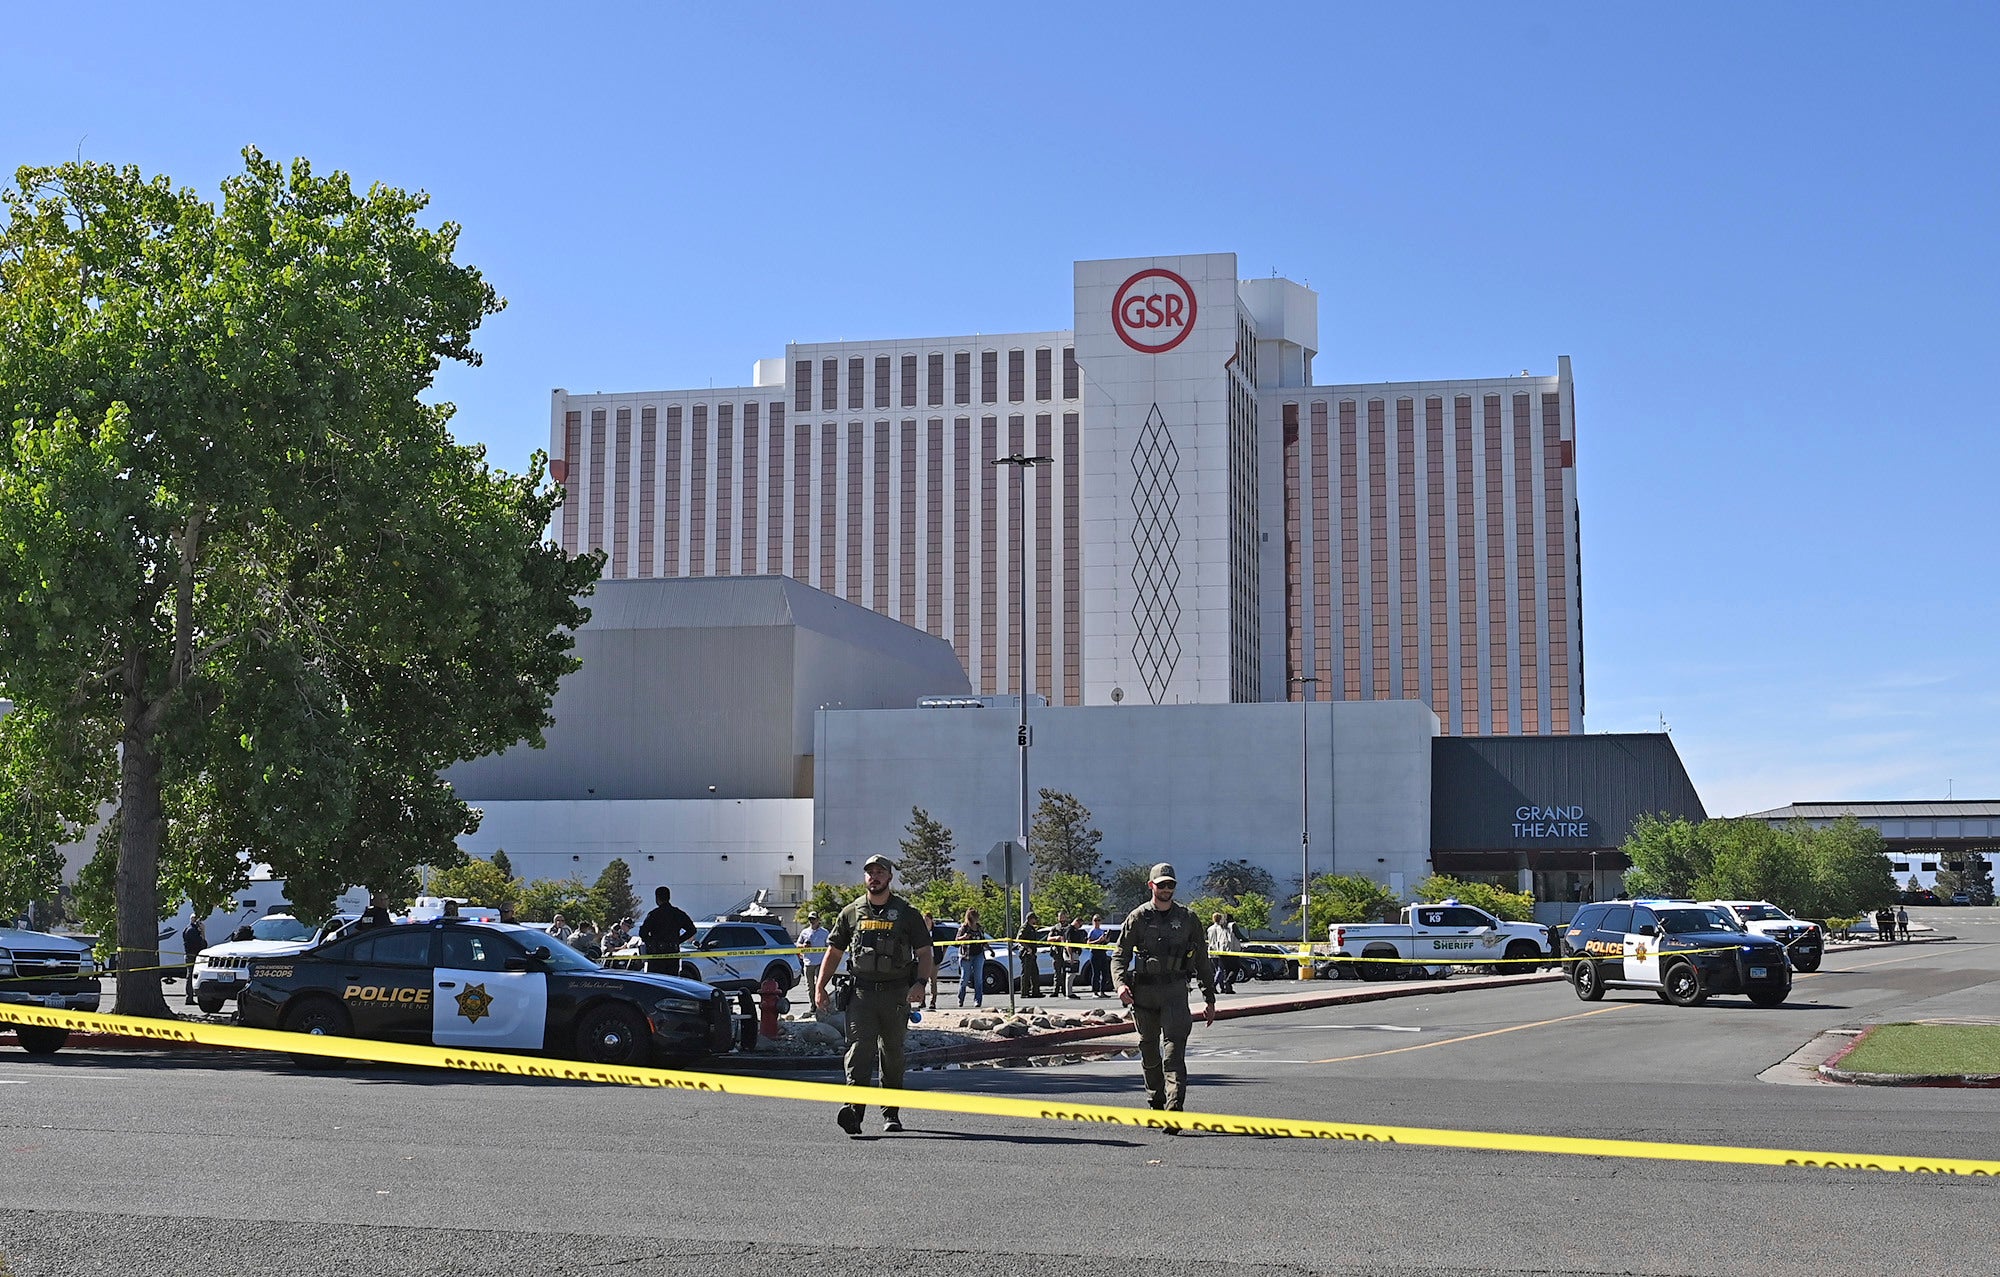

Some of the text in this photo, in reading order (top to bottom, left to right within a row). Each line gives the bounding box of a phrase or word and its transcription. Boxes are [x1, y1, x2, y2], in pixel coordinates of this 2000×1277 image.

[1121, 293, 1184, 329] GSR
[1515, 805, 1584, 821] GRAND
[1511, 822, 1589, 838] THEATRE
[1429, 914, 1441, 923] K9
[1585, 940, 1624, 955] POLICE
[253, 969, 294, 978] 334-COPS
[342, 985, 432, 1004] POLICE
